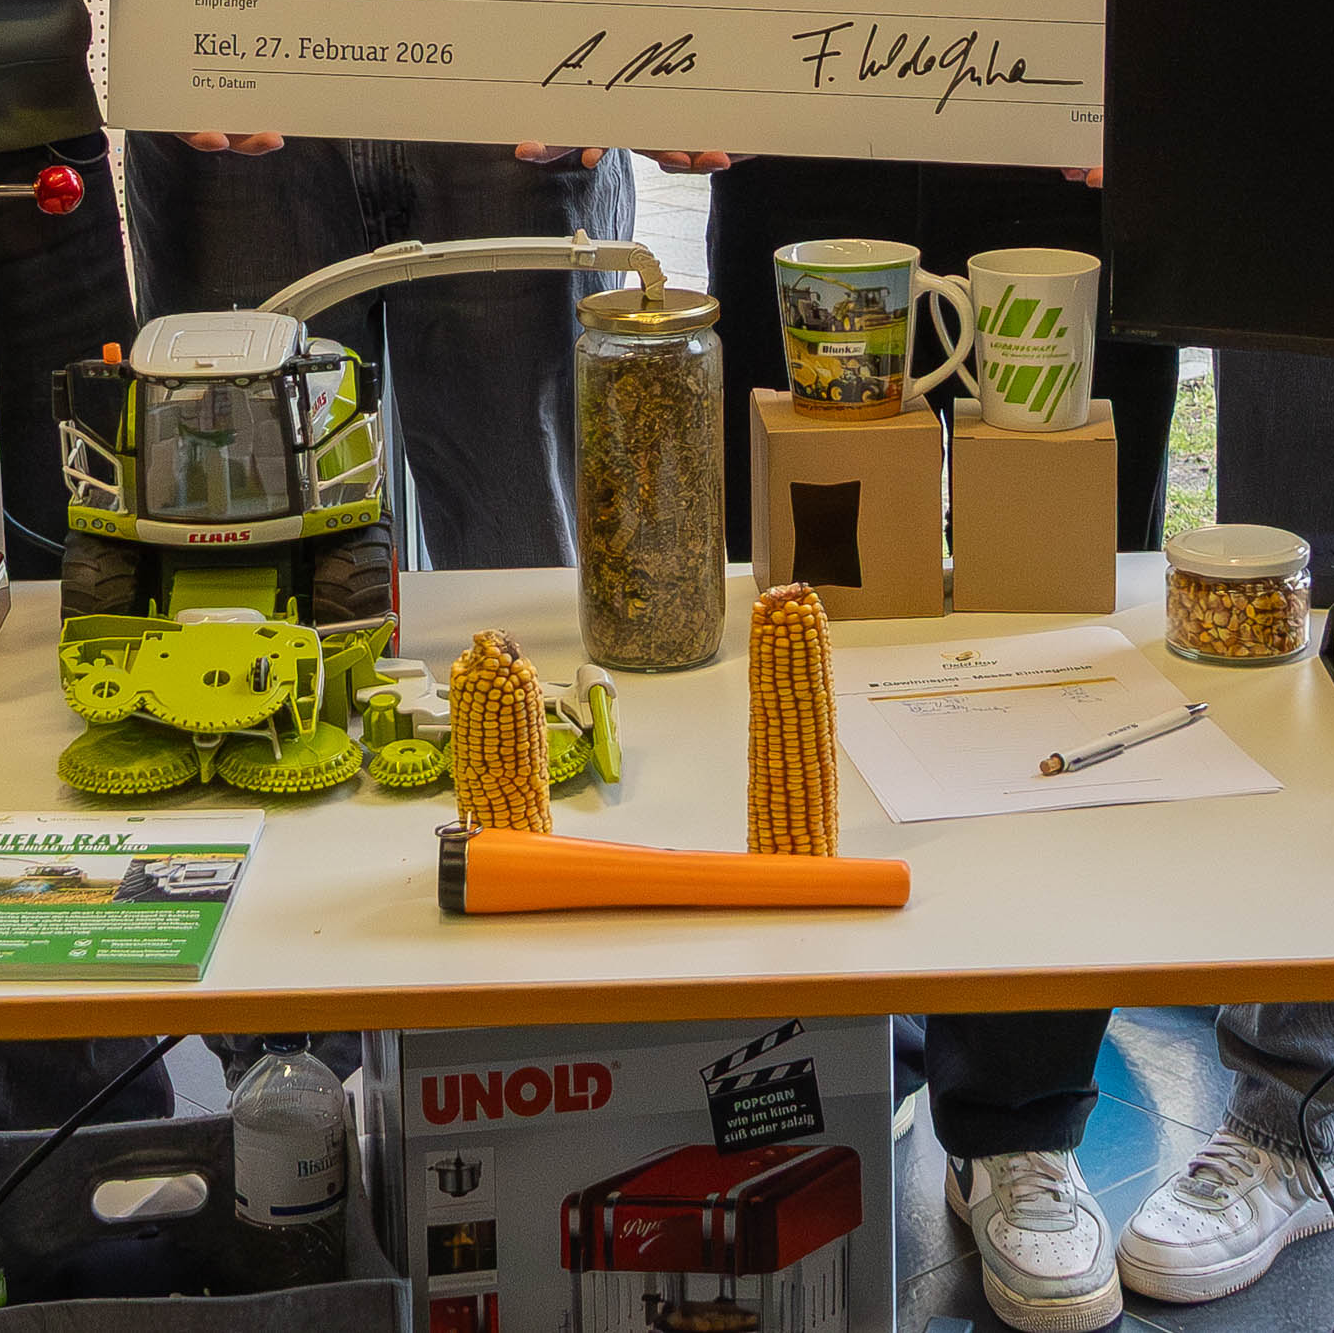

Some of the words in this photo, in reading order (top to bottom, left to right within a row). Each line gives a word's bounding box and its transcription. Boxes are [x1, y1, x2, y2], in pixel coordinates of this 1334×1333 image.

[193, 34, 247, 62] Kiel,
[254, 36, 291, 60] 27.
[298, 37, 389, 63] Februar
[396, 40, 454, 65] 2026
[192, 76, 216, 91] Ort,
[218, 77, 256, 90] Datum
[189, 530, 251, 543] CLAAS
[72, 833, 133, 846] RAY
[422, 1062, 613, 1125] UNOLD
[734, 1088, 795, 1112] POPCORN
[724, 1128, 747, 1143] süß
[750, 1122, 778, 1137] oder
[781, 1113, 815, 1129] salzig
[727, 1115, 749, 1129] wie
[751, 1112, 767, 1123] im
[770, 1104, 797, 1118] Kino
